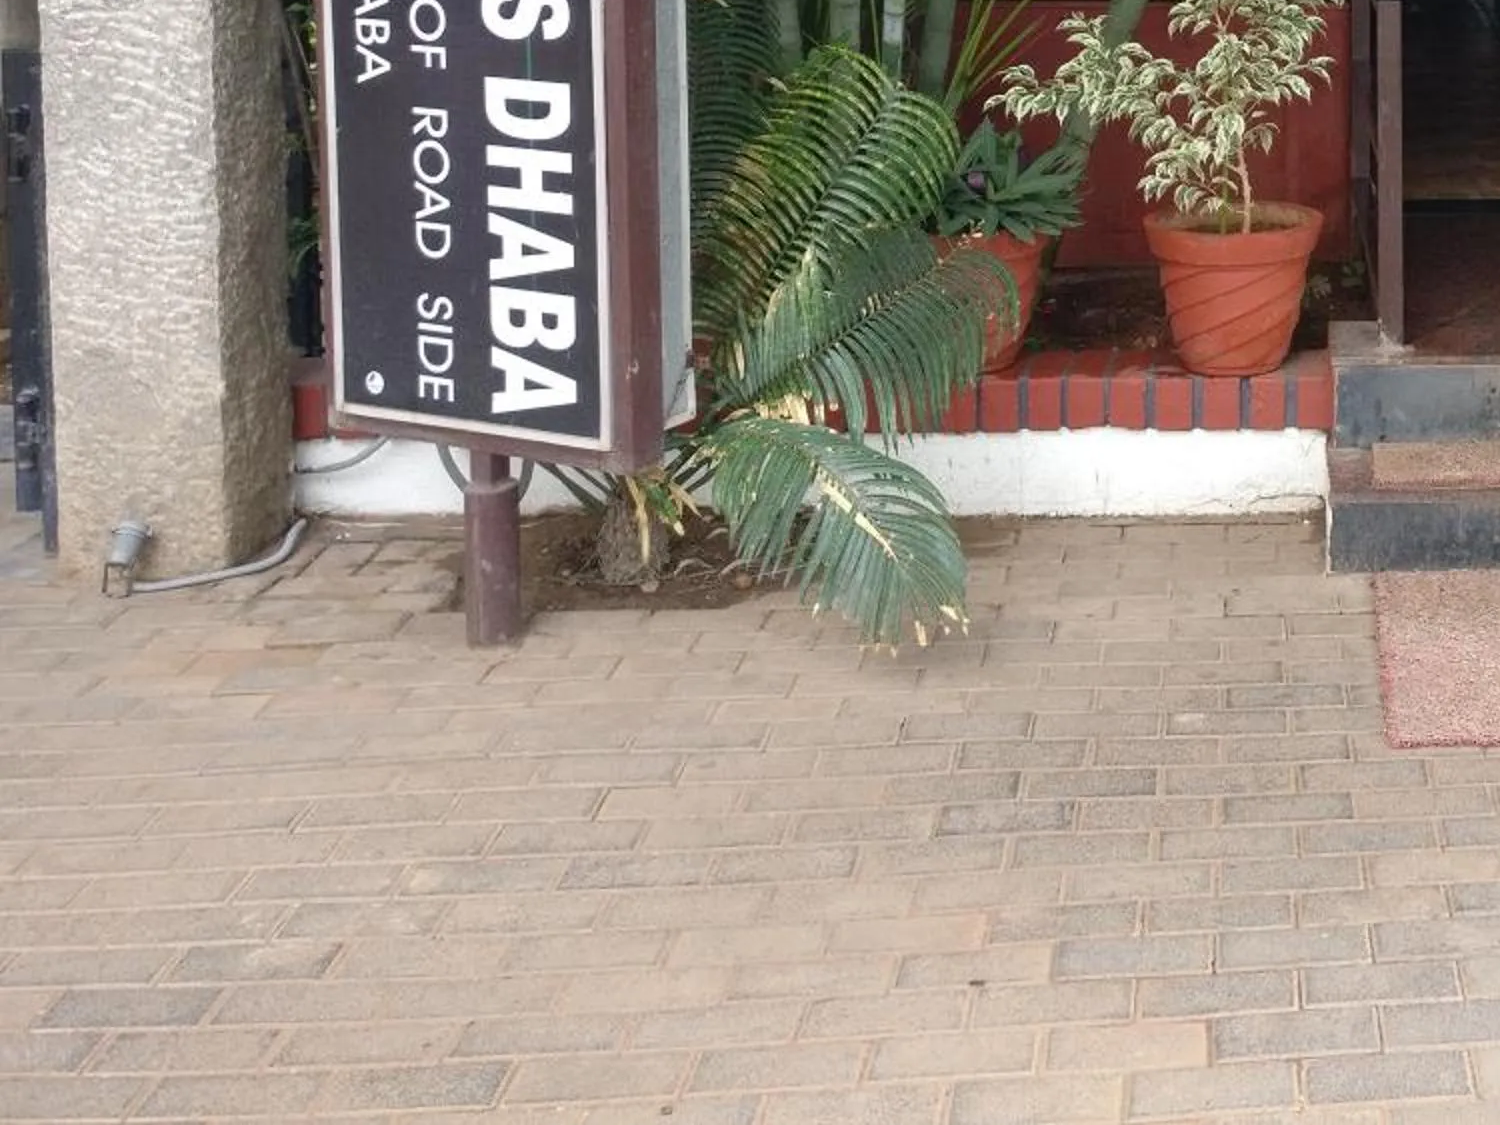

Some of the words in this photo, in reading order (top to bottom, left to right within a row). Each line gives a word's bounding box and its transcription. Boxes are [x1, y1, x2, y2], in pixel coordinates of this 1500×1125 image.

[411, 106, 452, 260] ROAD
[483, 76, 578, 414] DHABA
[416, 292, 455, 403] SIDE
